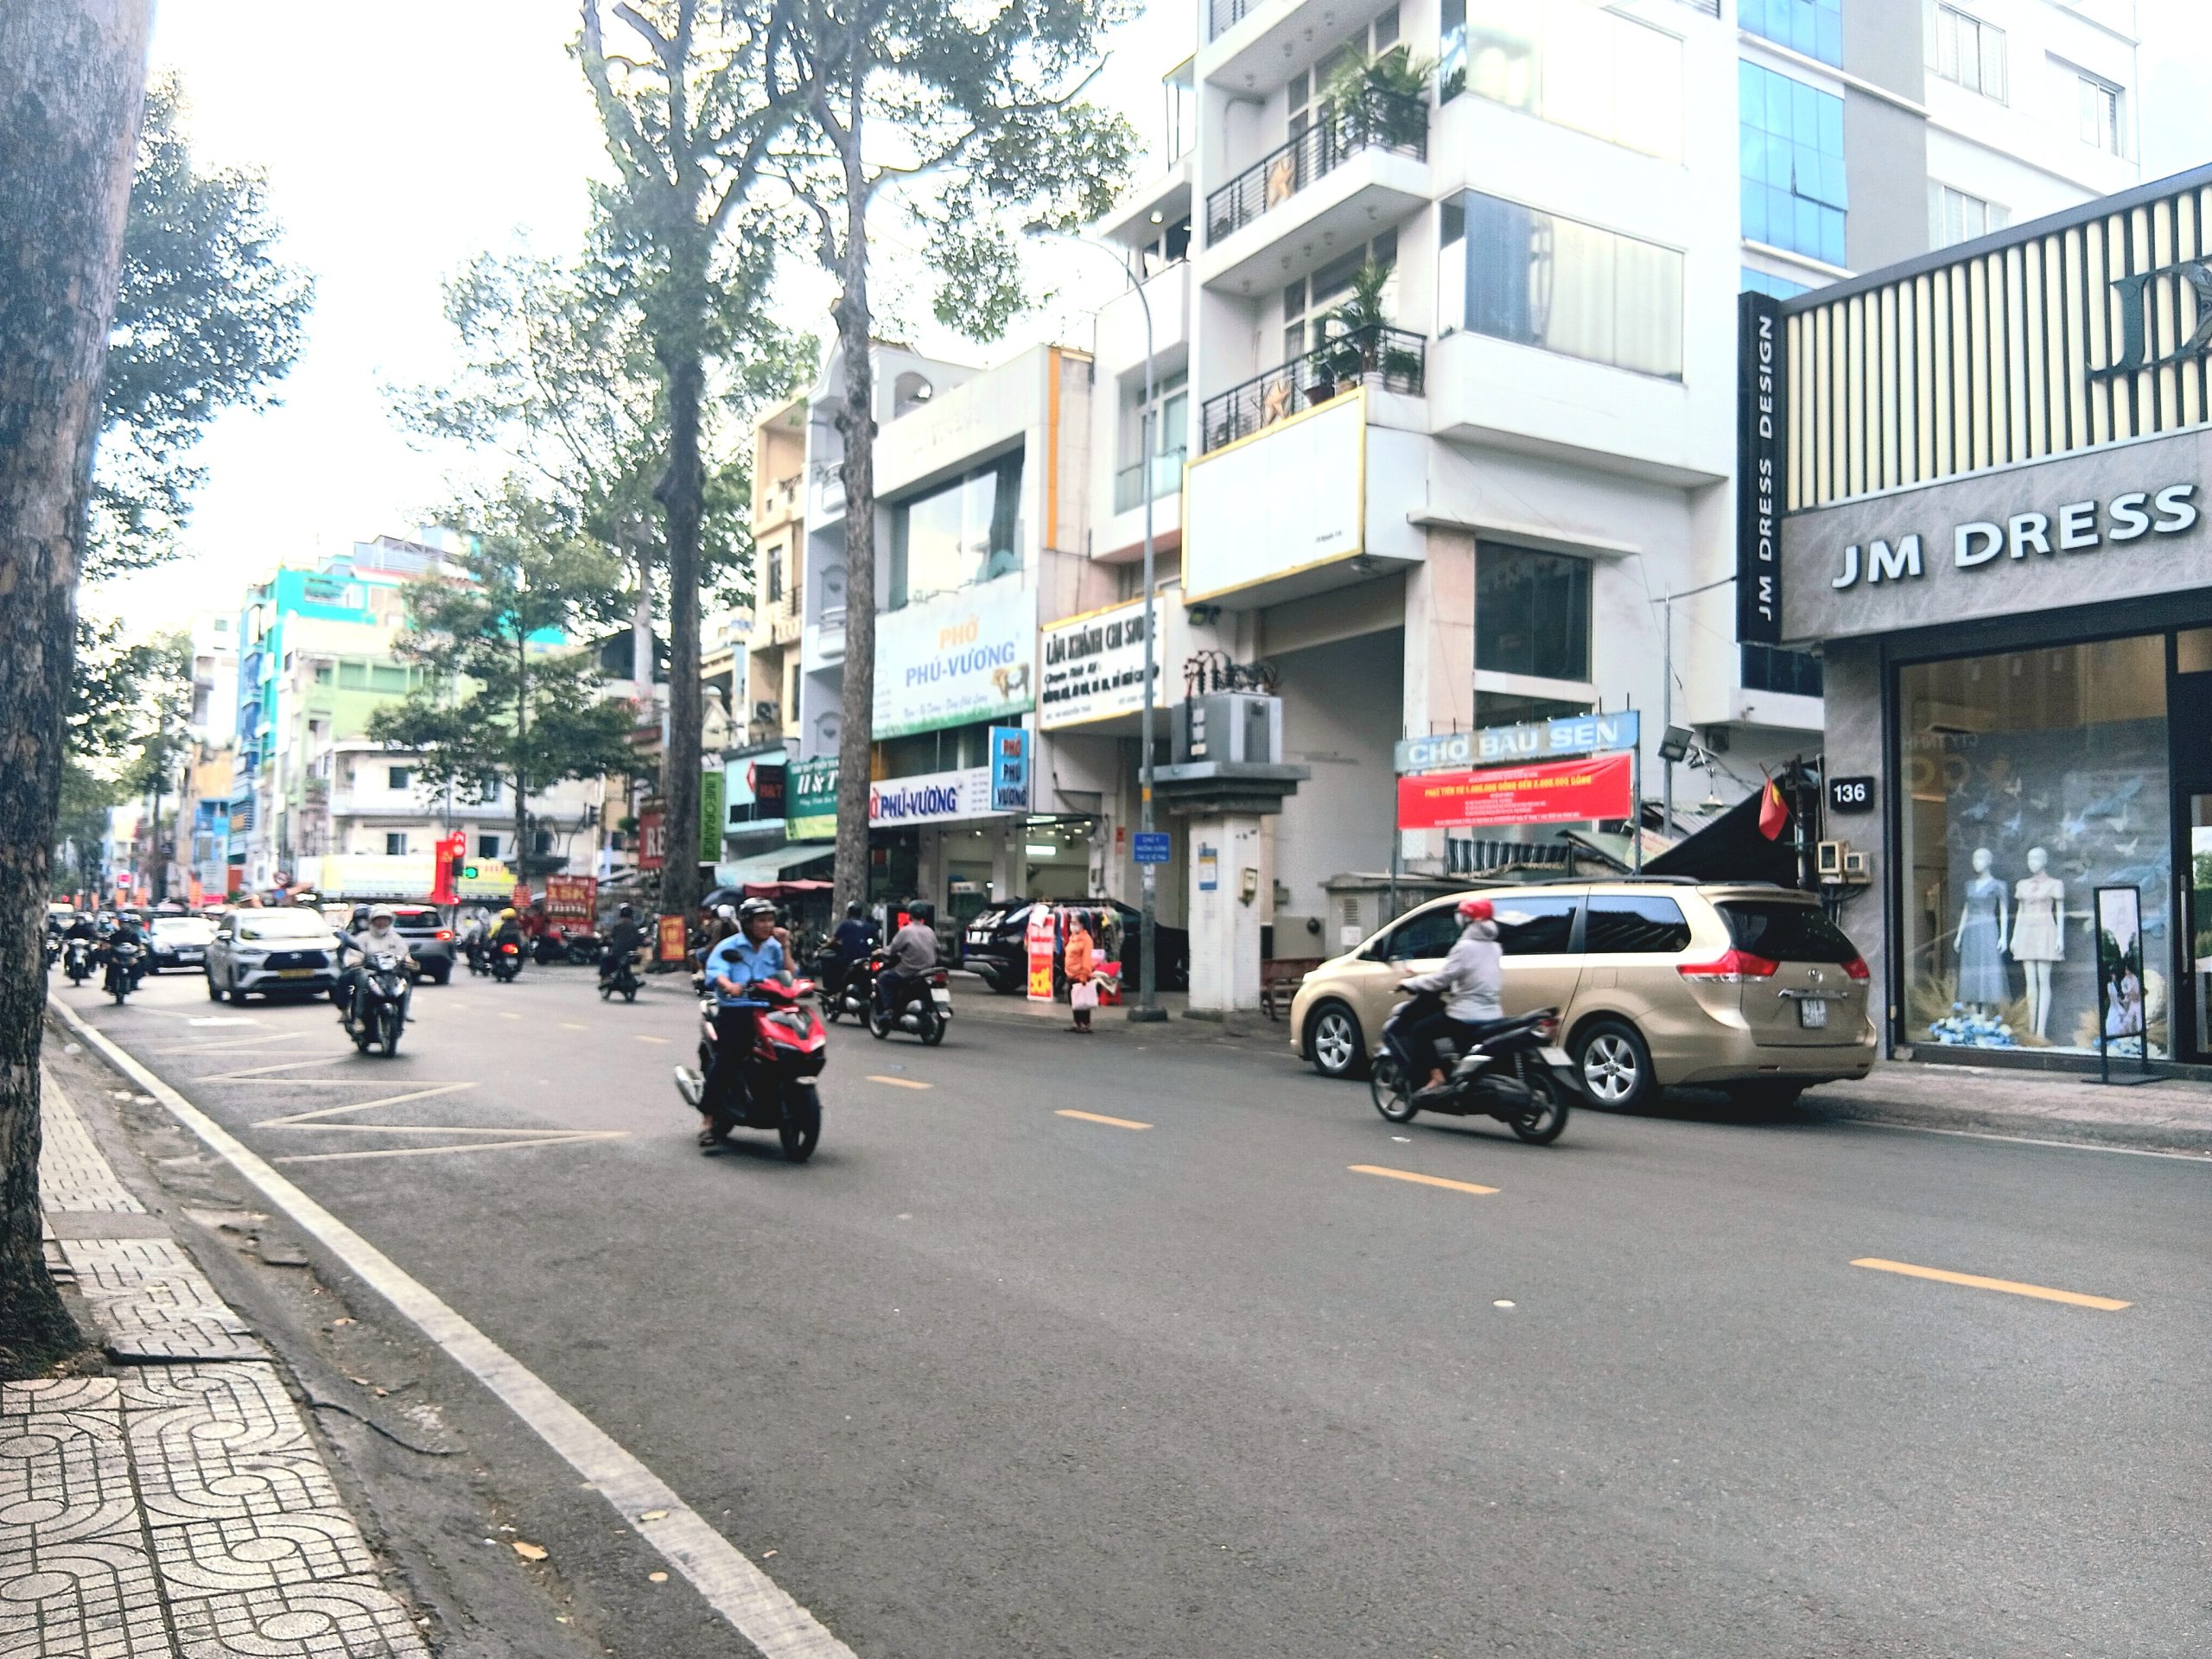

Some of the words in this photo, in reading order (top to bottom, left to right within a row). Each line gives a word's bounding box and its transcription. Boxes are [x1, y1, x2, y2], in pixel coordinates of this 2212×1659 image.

[1758, 315, 1773, 440] DESIGN
[1758, 458, 1772, 562] DRESS
[1831, 533, 1924, 590] JM
[1953, 483, 2200, 569] DRESS
[1758, 576, 1772, 621] JM
[938, 612, 979, 651] PHỞ
[906, 641, 1015, 688] PHÚ-VƯƠNG
[1549, 720, 1618, 748] SEN
[1834, 783, 1866, 803] 136
